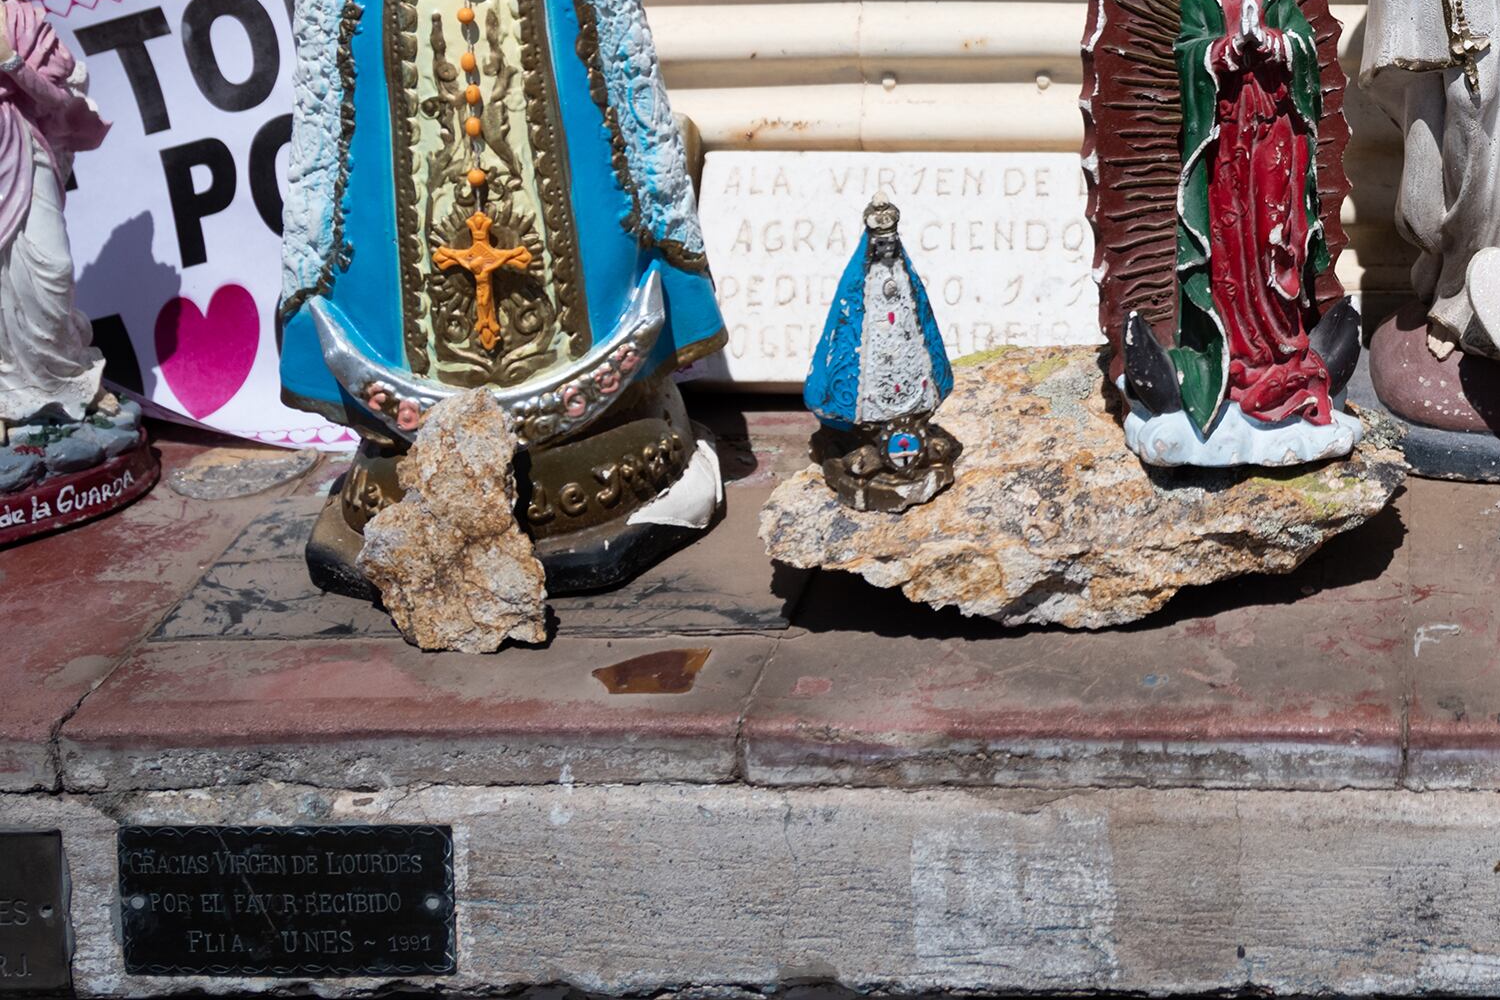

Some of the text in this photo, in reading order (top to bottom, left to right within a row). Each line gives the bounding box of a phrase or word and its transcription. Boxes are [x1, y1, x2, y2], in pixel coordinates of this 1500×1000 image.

[1003, 167, 1051, 197] DE
[31, 496, 52, 524] la
[56, 469, 135, 513] GUARDA
[128, 850, 423, 876] GRACIAS VIRGEN DE LOURDES
[199, 893, 225, 914] EL
[303, 891, 401, 914] RECIBIDO
[387, 935, 433, 953] 1991
